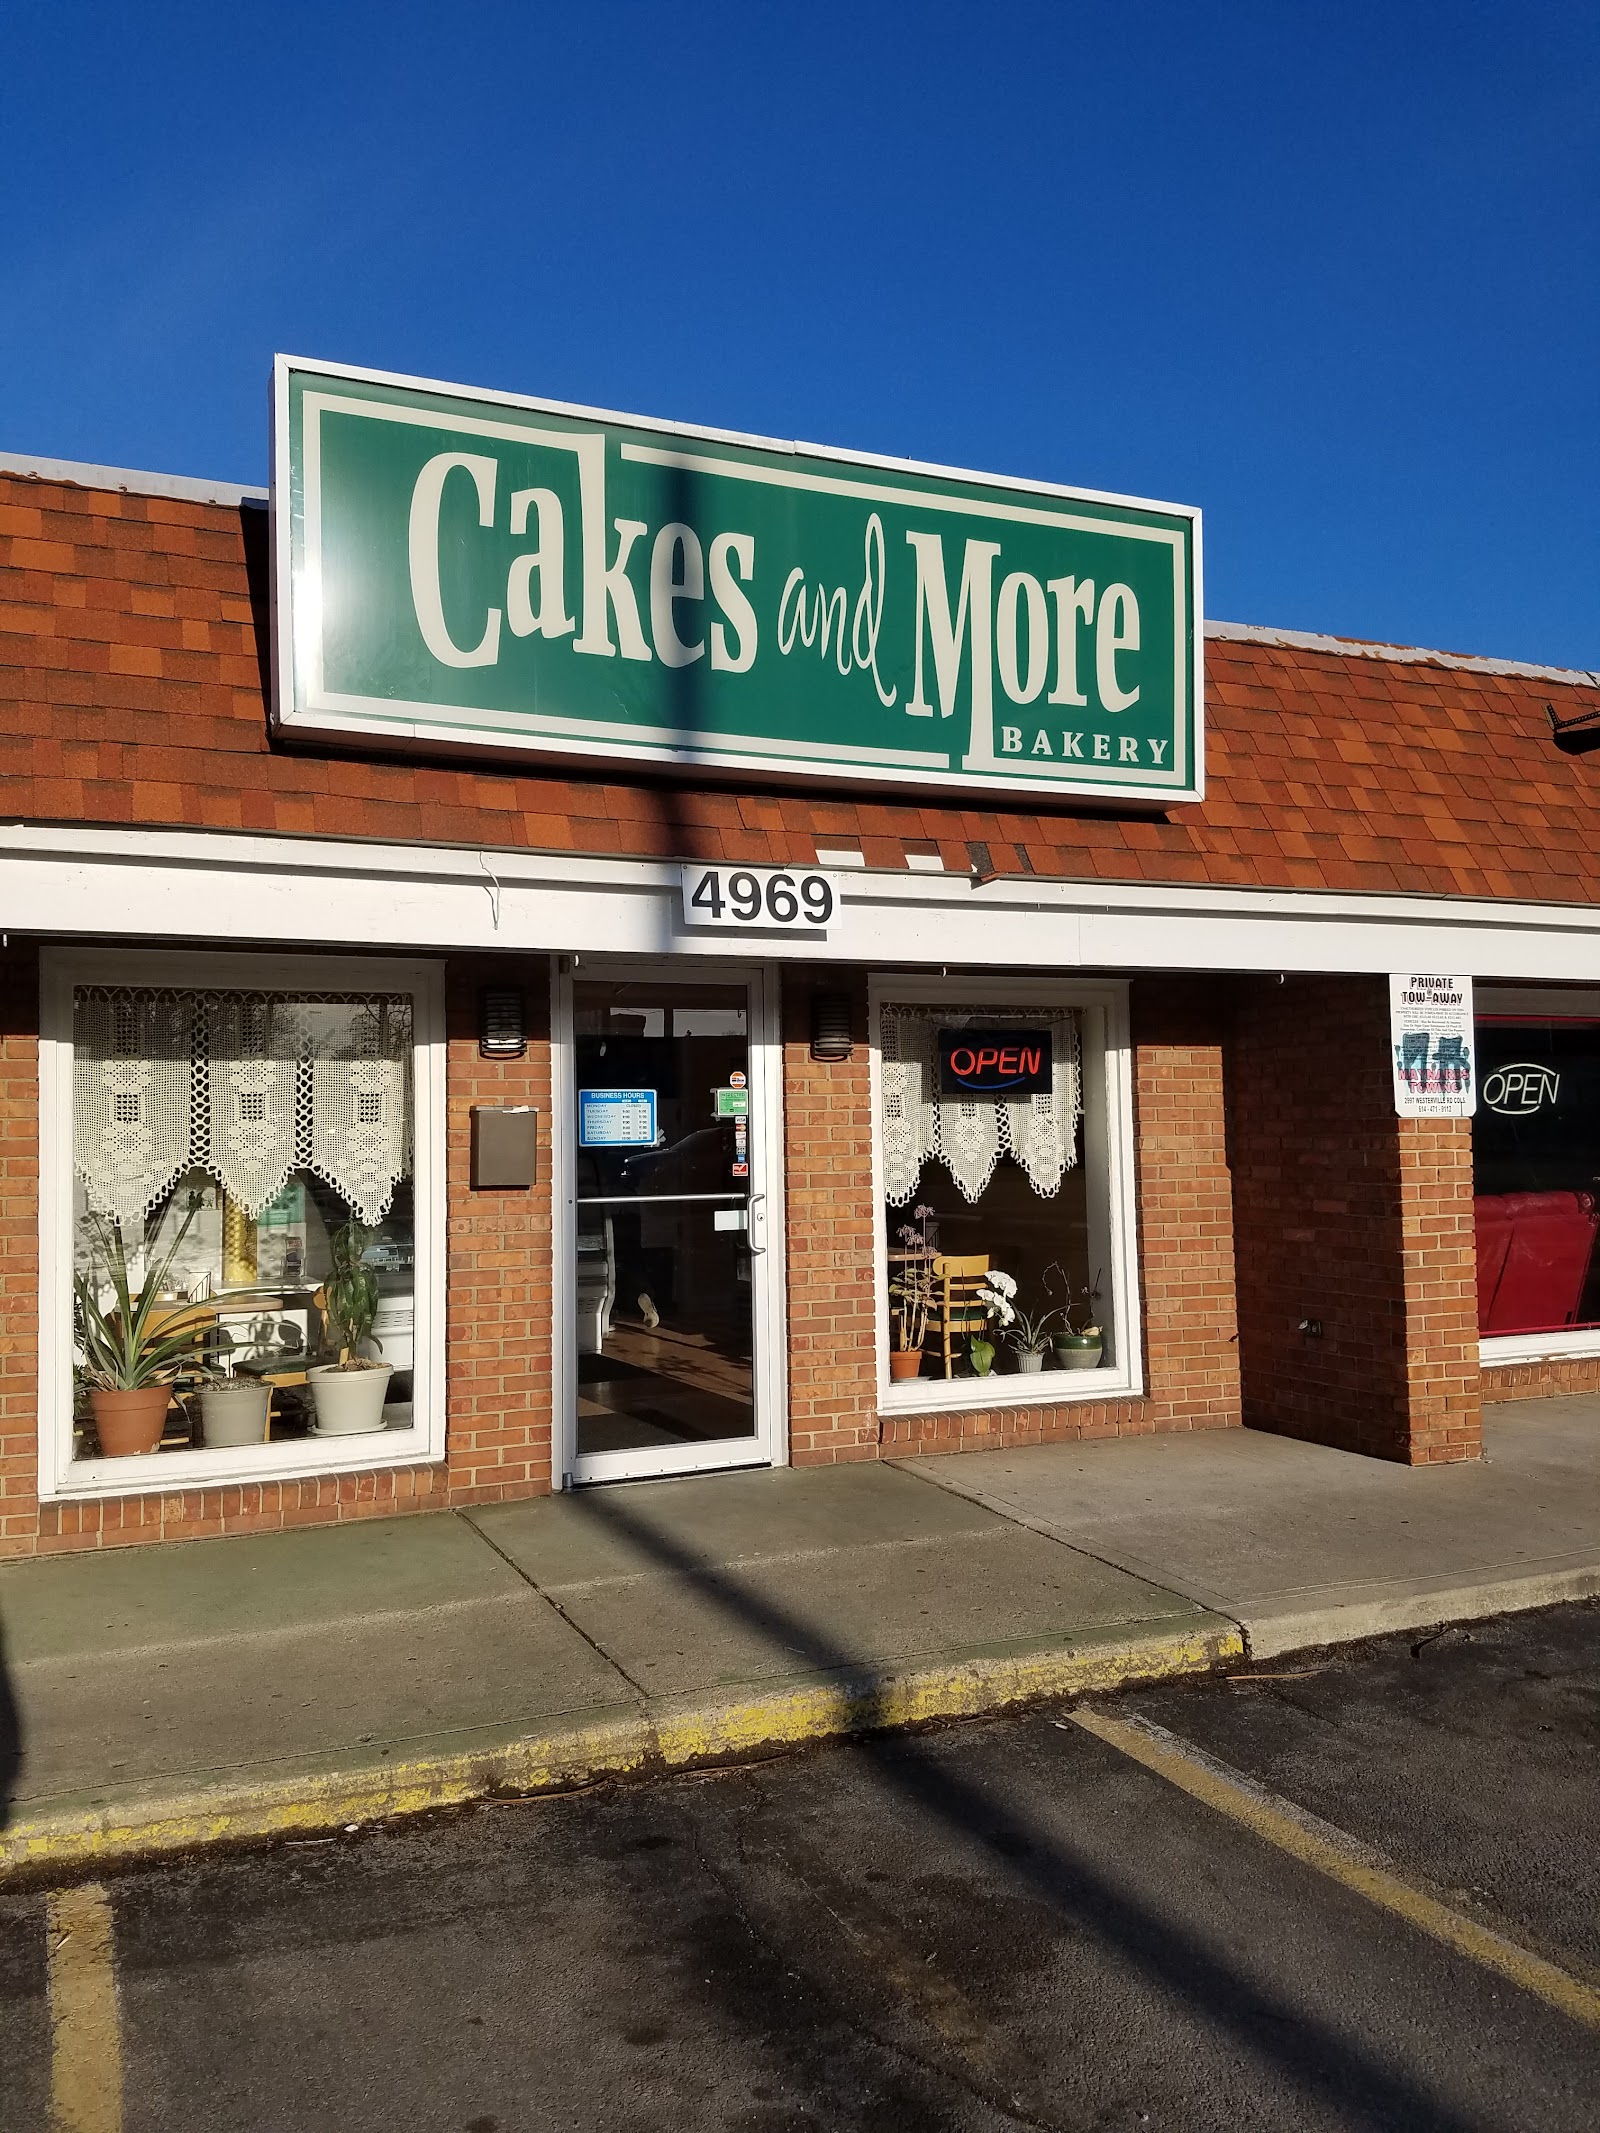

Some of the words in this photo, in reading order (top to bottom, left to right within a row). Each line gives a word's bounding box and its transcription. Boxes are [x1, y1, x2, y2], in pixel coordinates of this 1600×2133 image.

[408, 434, 757, 674] Cakes
[778, 512, 897, 708] and
[905, 529, 1141, 771] More
[1001, 726, 1168, 765] BAKERY
[691, 870, 833, 925] 4969
[1401, 991, 1463, 1005] TOW-AWAY
[1410, 976, 1454, 990] PRIVATE
[951, 1047, 1041, 1076] OPEN
[1409, 1081, 1458, 1094] TOWING
[1483, 1073, 1560, 1105] OPEN
